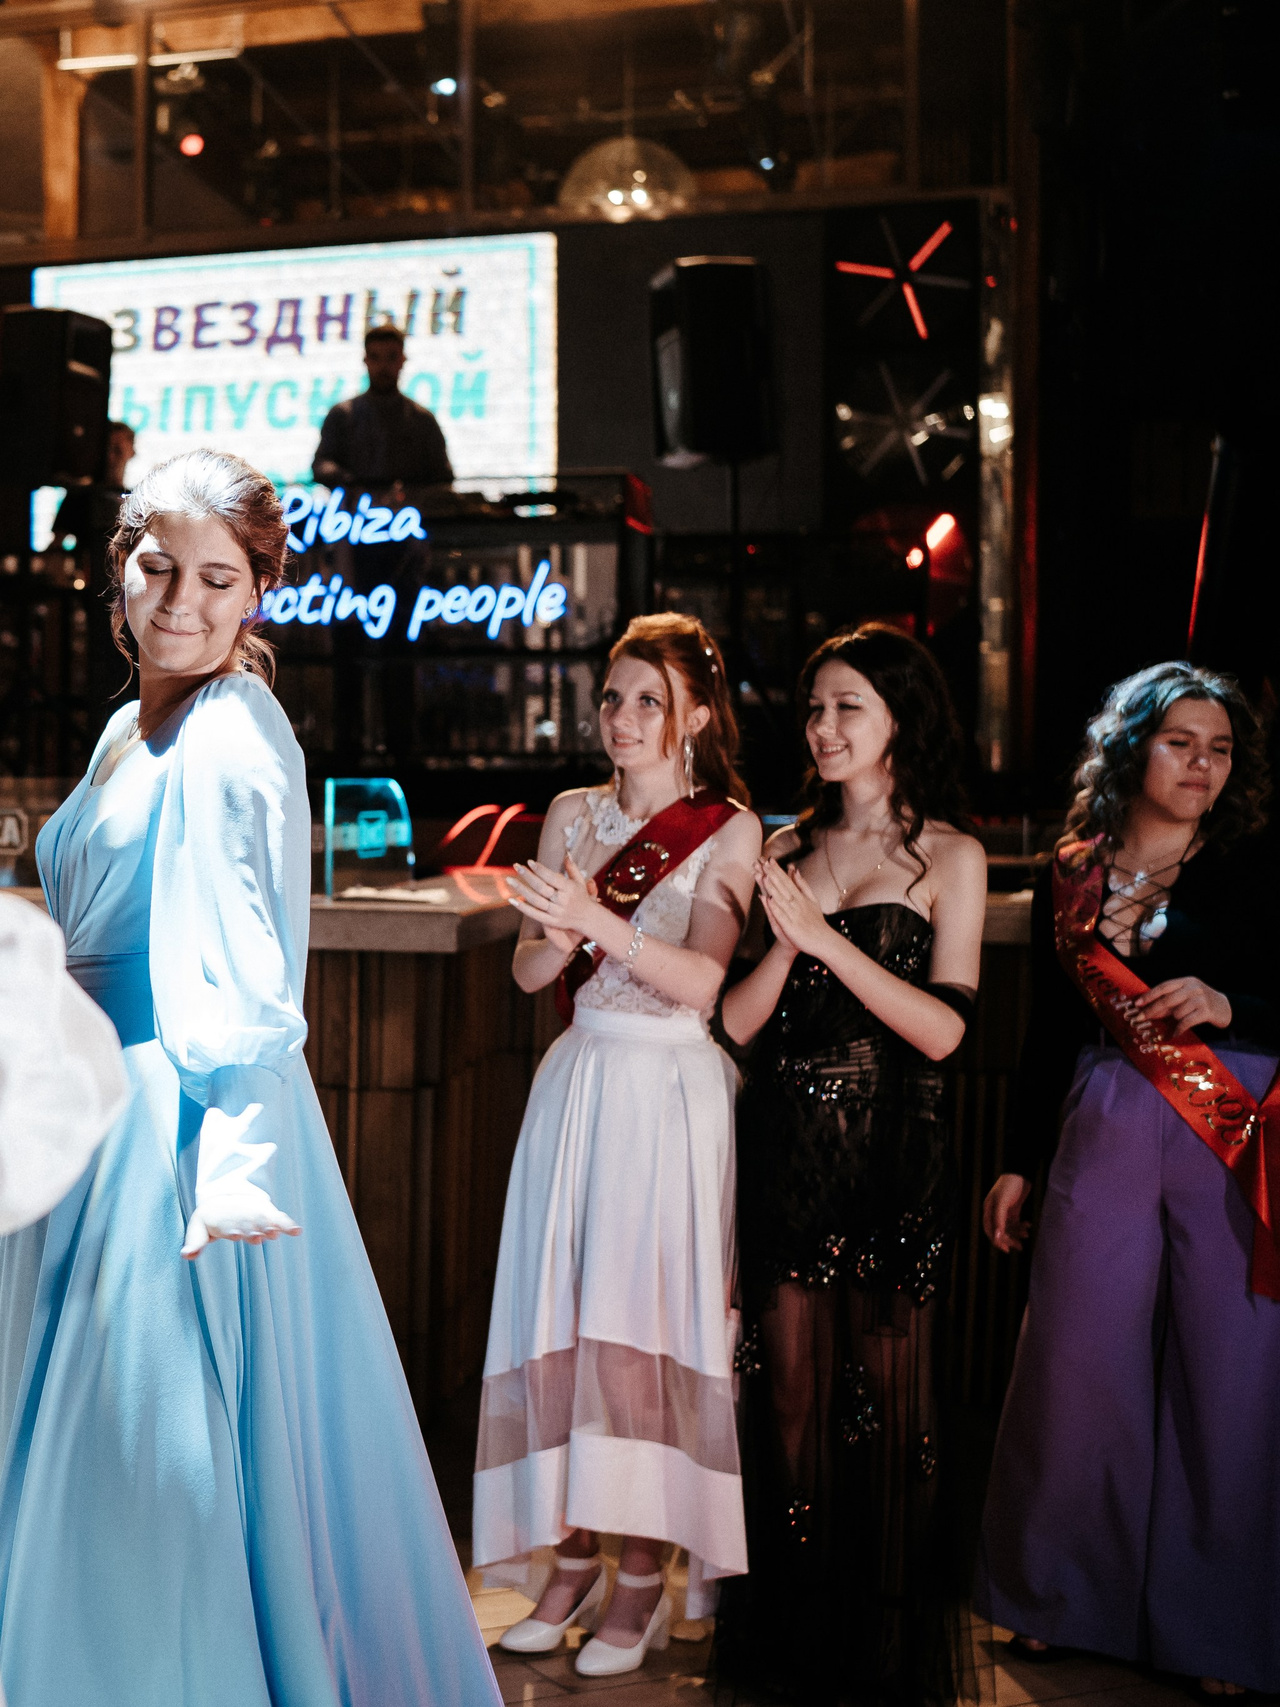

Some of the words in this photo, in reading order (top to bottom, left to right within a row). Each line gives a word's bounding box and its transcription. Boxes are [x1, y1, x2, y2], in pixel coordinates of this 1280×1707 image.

[112, 266, 469, 356] ЗВЕЗДНЫЙ
[121, 350, 491, 434] ЫПУСКОЙ
[406, 559, 568, 642] people
